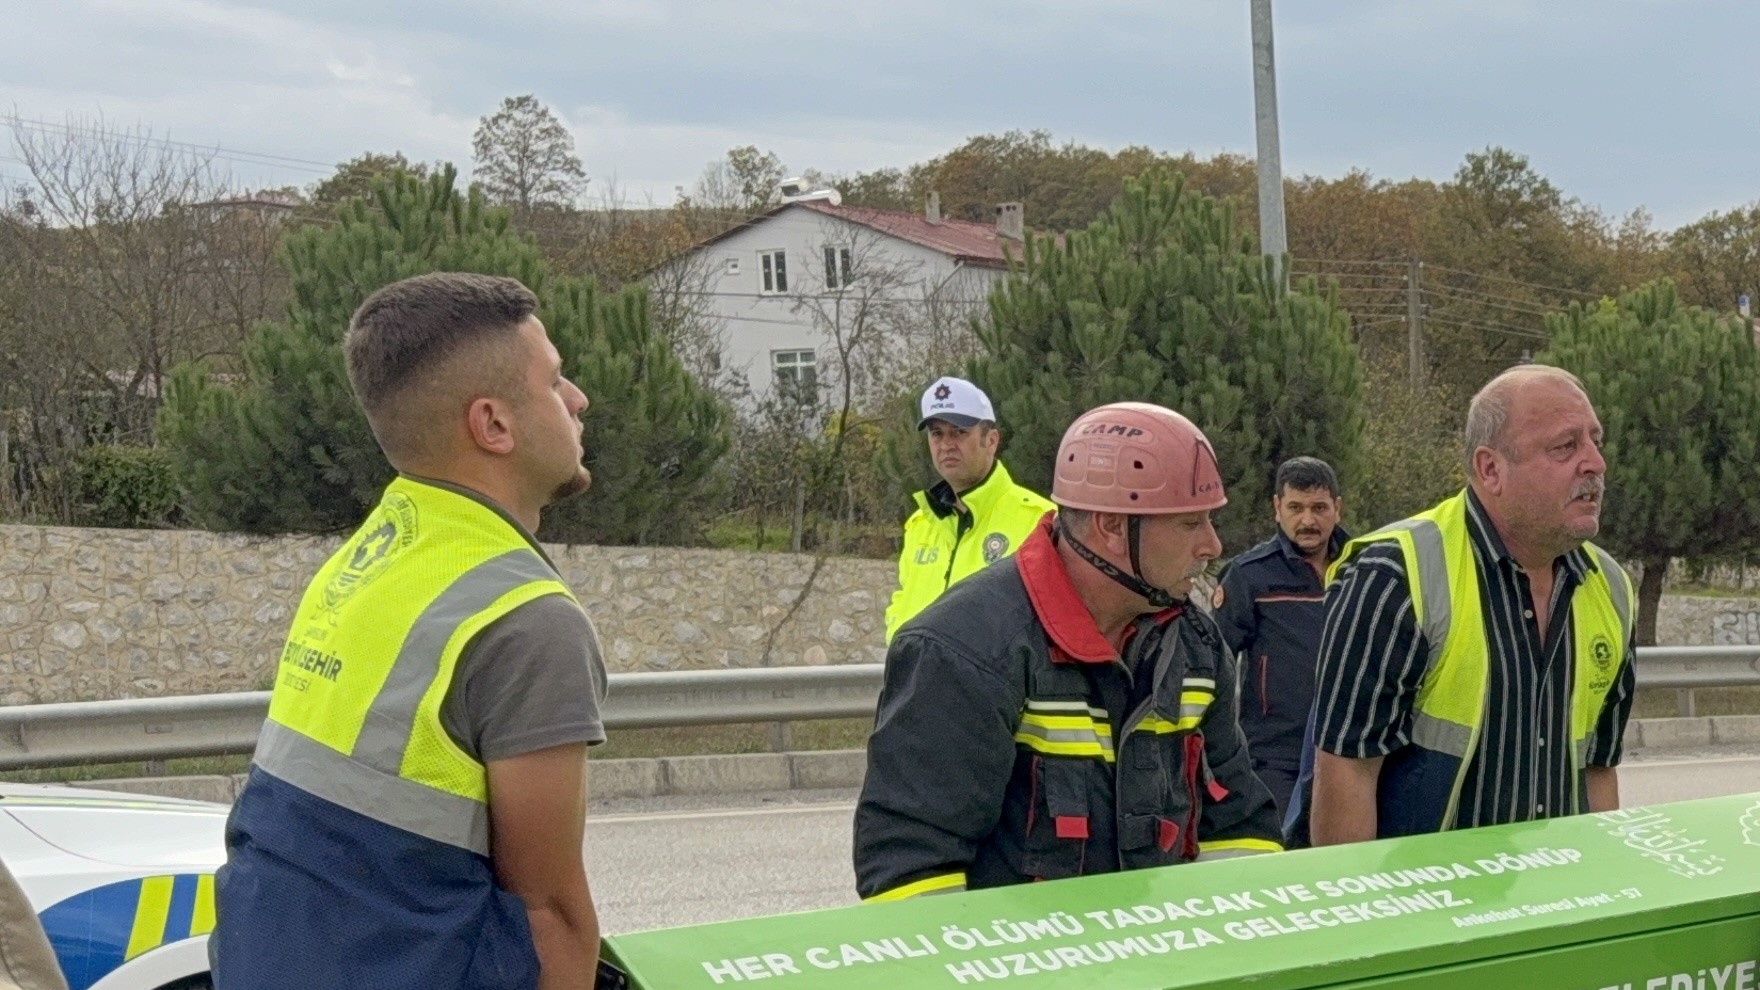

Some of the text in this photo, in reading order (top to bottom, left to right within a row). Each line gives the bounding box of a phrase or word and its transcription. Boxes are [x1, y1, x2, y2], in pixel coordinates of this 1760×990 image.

[1083, 424, 1144, 438] CAMP
[702, 846, 1583, 984] HER CANLI ÖLÜMÜ TADACAK VE SONUNDA DÖNÜP
[944, 889, 1473, 984] HUZURUMUZA GELECEKSİNİZ.
[1452, 905, 1526, 928] Ankebut
[1620, 887, 1643, 899] 57
